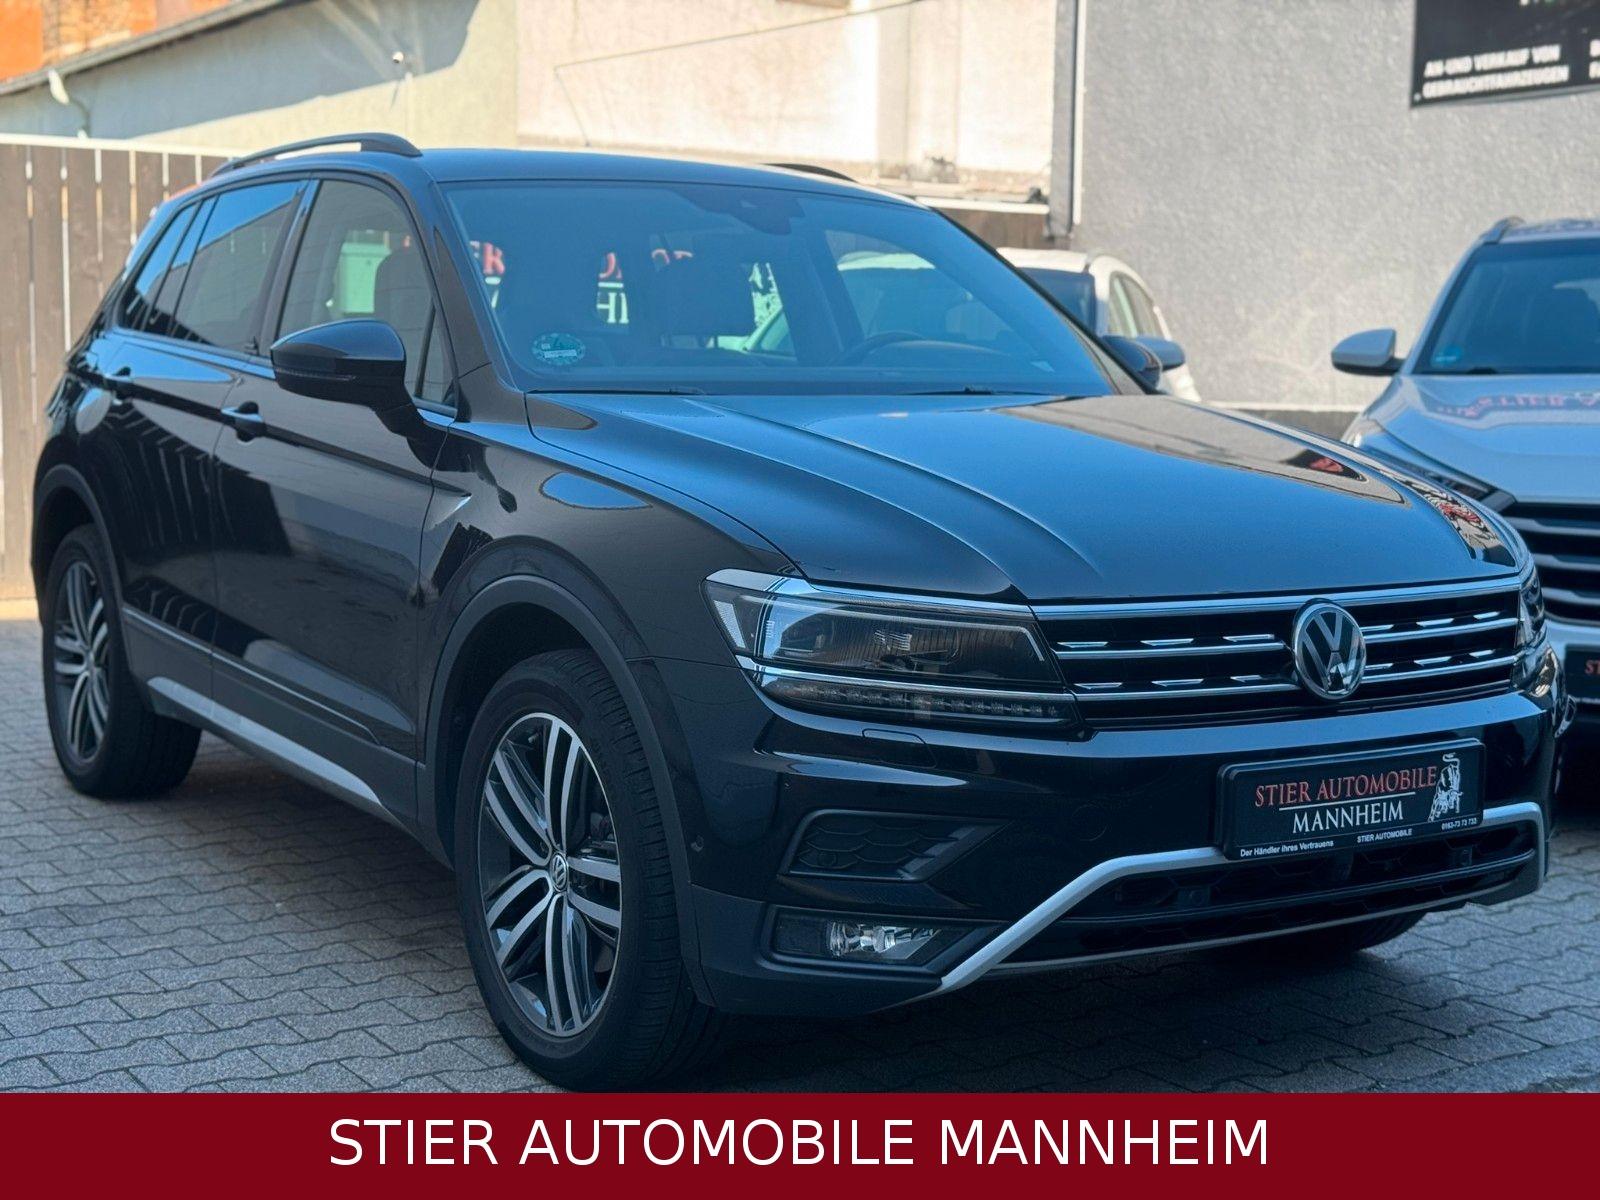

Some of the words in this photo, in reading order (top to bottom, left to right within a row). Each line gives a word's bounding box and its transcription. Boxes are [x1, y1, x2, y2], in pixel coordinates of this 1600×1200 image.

[1424, 60, 1444, 78] AN
[1445, 55, 1473, 76] UND
[1473, 48, 1530, 71] VERKAUF
[1531, 44, 1561, 64] VON
[1254, 781, 1312, 807] STIER
[1316, 766, 1438, 801] AUTOMOBILE
[1292, 800, 1404, 834] MANNHEIM
[1240, 848, 1253, 857] Der
[1253, 845, 1280, 856] Händler
[1299, 840, 1335, 851] Vertrauens
[1357, 834, 1375, 844] STIER
[1375, 828, 1413, 841] AUTOMOBILE
